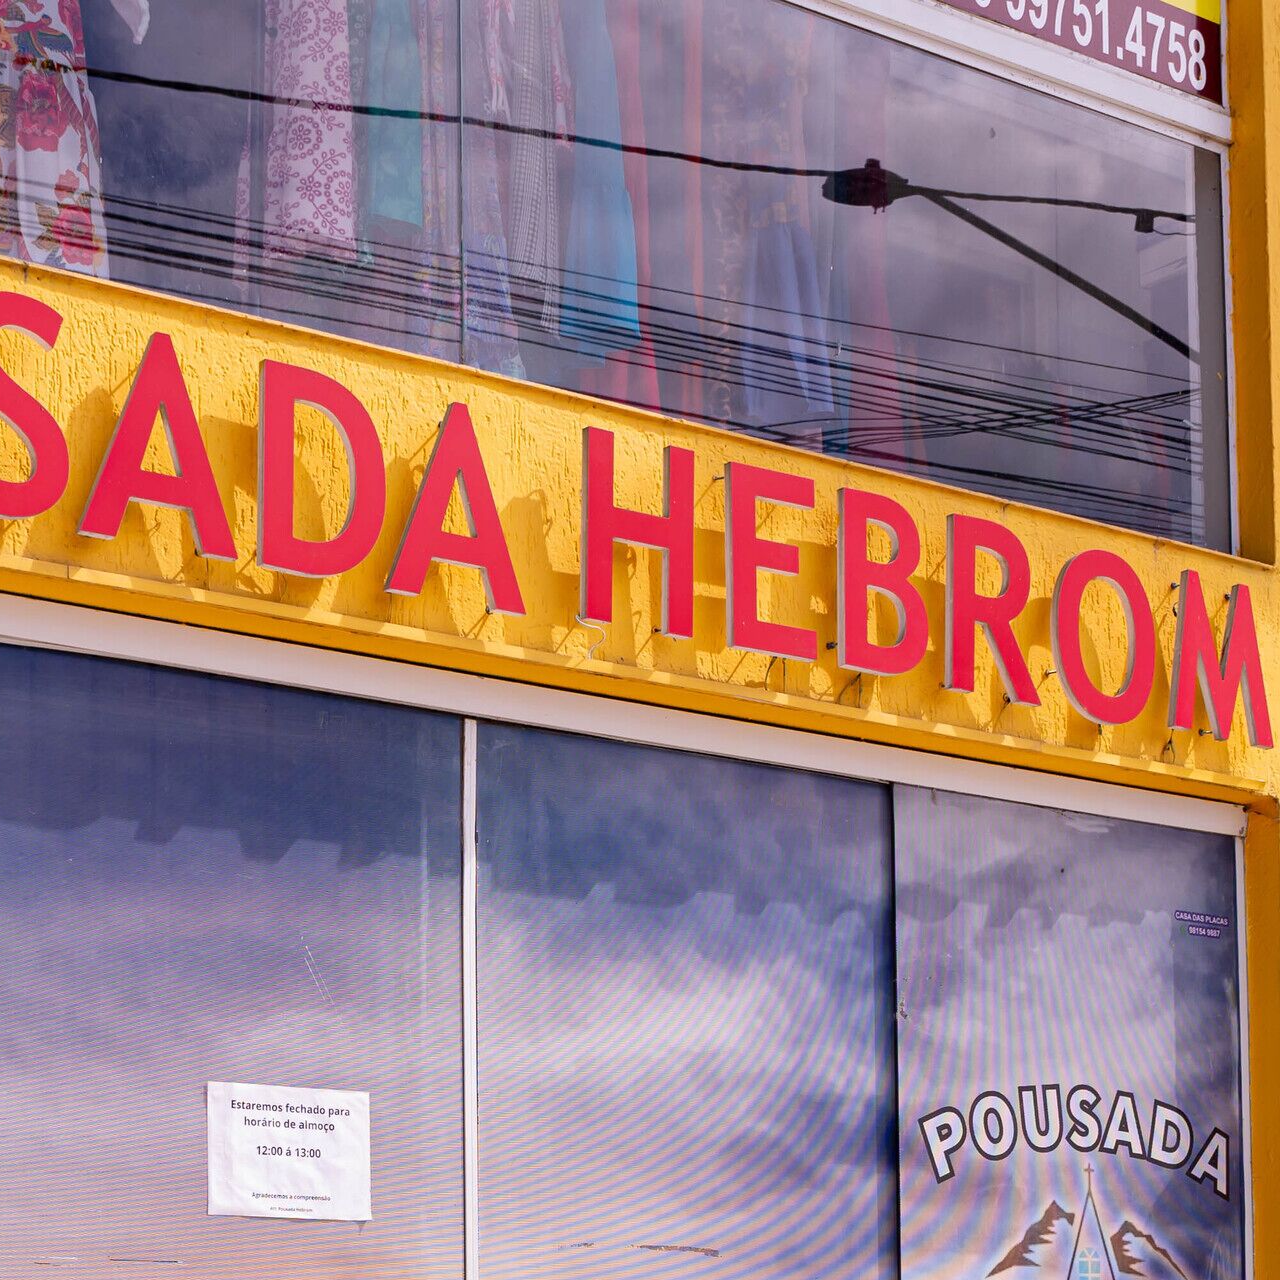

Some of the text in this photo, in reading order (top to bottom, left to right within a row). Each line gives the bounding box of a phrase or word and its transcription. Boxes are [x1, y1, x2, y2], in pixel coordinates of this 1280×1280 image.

[579, 426, 1272, 748] HEBROM
[1175, 911, 1192, 920] CASA
[1205, 916, 1229, 926] PLACAS
[231, 1099, 350, 1118] Estaremos fechado para
[244, 1116, 335, 1133] horário de almoço
[918, 1084, 1230, 1200] POUSADA
[256, 1145, 282, 1156] 12:00
[295, 1147, 321, 1159] 13:00
